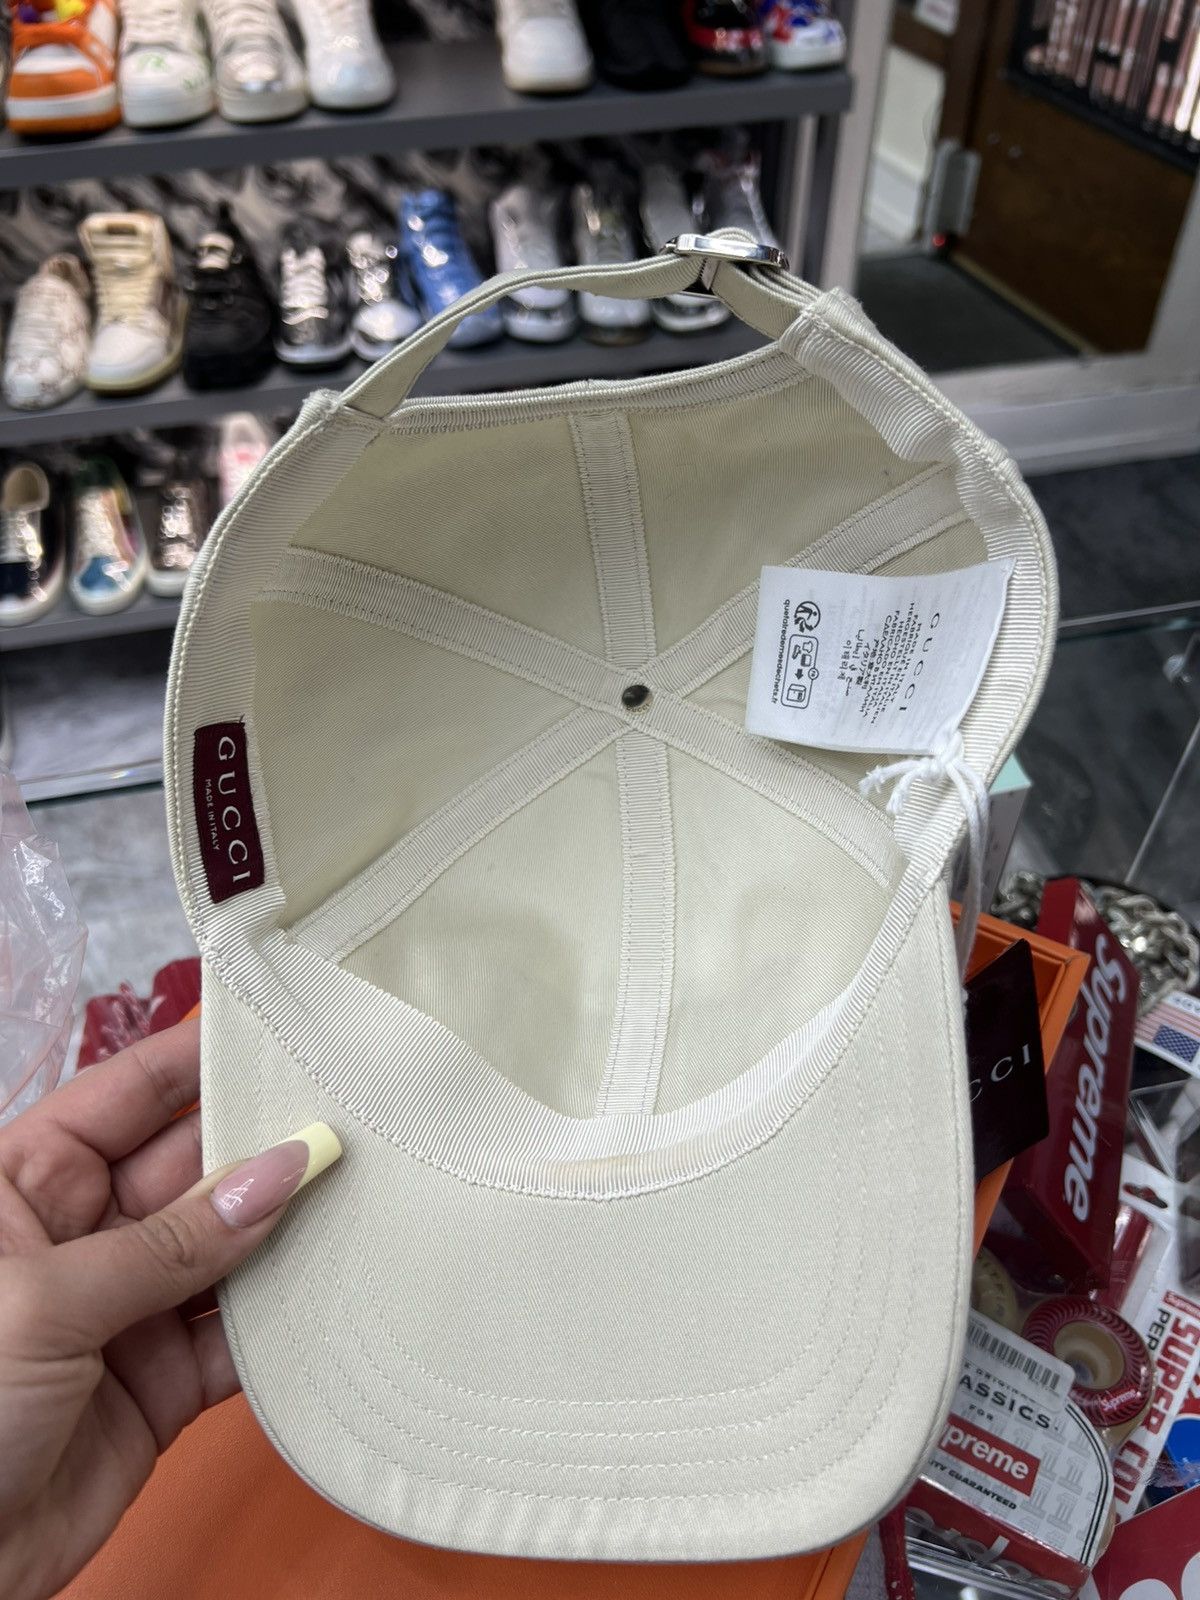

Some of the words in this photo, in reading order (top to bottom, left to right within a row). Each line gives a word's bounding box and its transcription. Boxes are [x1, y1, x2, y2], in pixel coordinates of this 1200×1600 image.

[771, 599, 790, 704] quefairedemesdechets.fr
[882, 611, 900, 668] FABRICADO
[891, 621, 904, 658] HECHO
[893, 603, 914, 671] HERGESTELLT
[899, 613, 939, 710] GUCCI
[910, 623, 922, 654] MADE
[892, 674, 905, 702] ITALY
[205, 778, 214, 809] MADE
[208, 810, 216, 823] IN
[218, 736, 250, 882] GUCCI
[209, 823, 220, 850] ITALY
[969, 1044, 1031, 1103] CCI
[1064, 933, 1126, 1222] Supreme
[960, 1374, 1050, 1429] ASSICS
[1144, 1316, 1200, 1436] SUPER
[969, 1404, 994, 1421] FOR
[941, 1423, 1029, 1480] preme
[949, 1469, 1017, 1510] GUARANTEED
